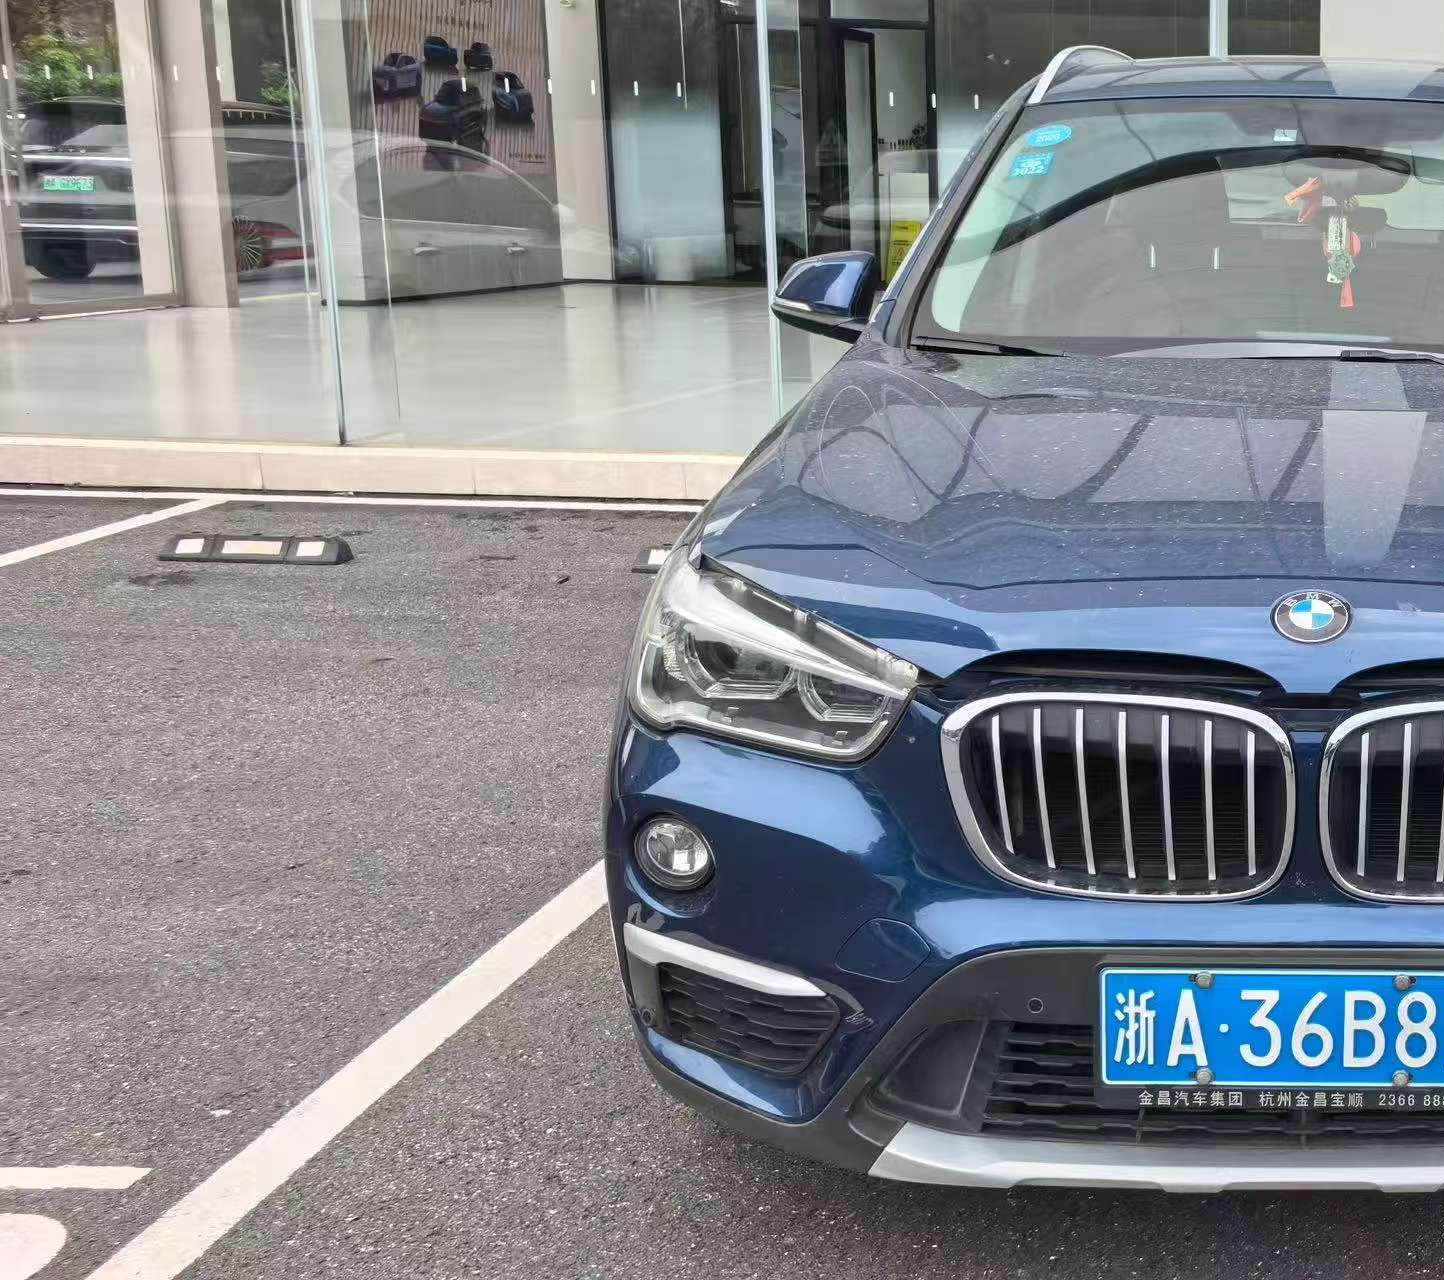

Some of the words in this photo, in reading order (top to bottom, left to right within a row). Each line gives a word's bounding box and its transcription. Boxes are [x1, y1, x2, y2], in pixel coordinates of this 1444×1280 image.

[1283, 592, 1342, 607] BMW
[1138, 1090, 1243, 1107] 金昌汽车集团
[1259, 1091, 1364, 1108] 杭州金昌宝顺
[1378, 1093, 1415, 1107] 2366
